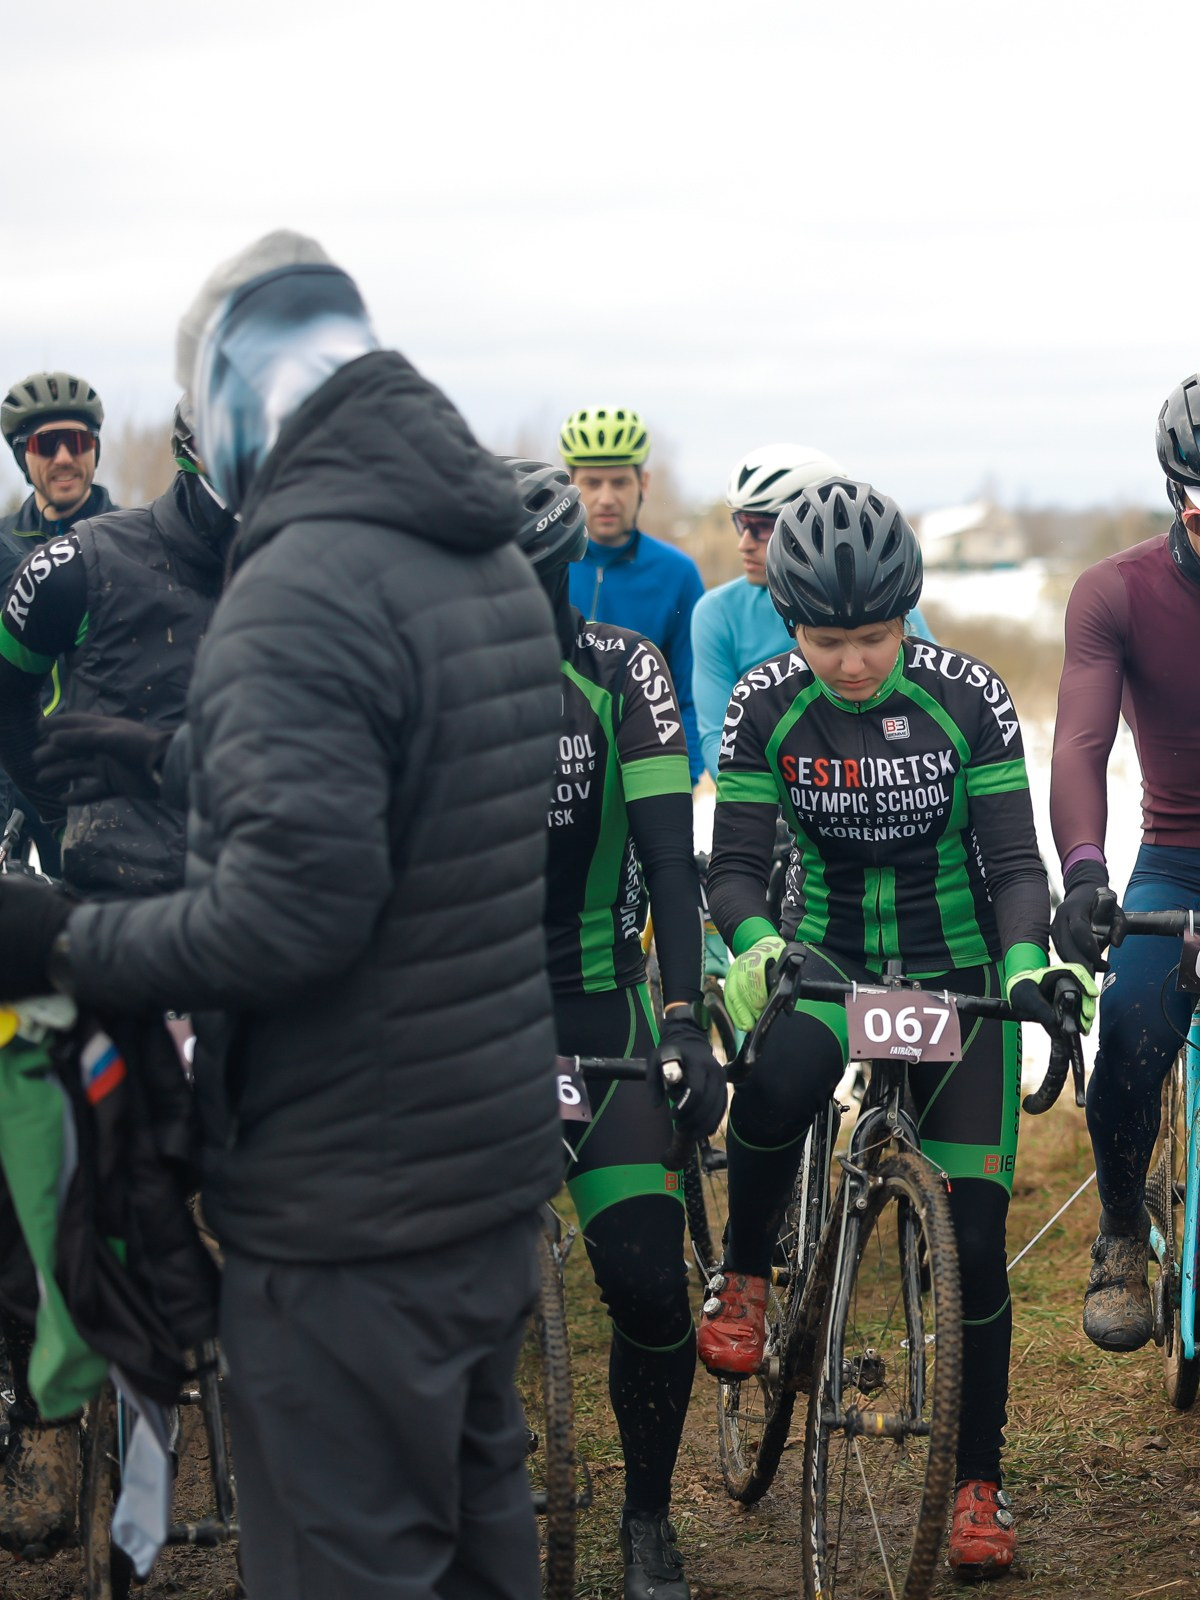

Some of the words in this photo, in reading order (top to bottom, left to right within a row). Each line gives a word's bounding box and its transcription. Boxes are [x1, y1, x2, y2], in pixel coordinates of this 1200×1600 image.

[548, 497, 572, 523] GIRO
[719, 652, 810, 760] RUSSIA
[908, 643, 1019, 747] RUSSIA
[782, 749, 956, 788] SESTRORETSK
[790, 787, 869, 814] OLYMPIC
[876, 783, 950, 813] SCHOOL
[797, 811, 823, 824] ST.
[830, 807, 945, 826] PETERSBURG
[818, 822, 932, 842] KORENKOV
[864, 1006, 950, 1045] 067
[889, 1046, 923, 1057] FATRACING
